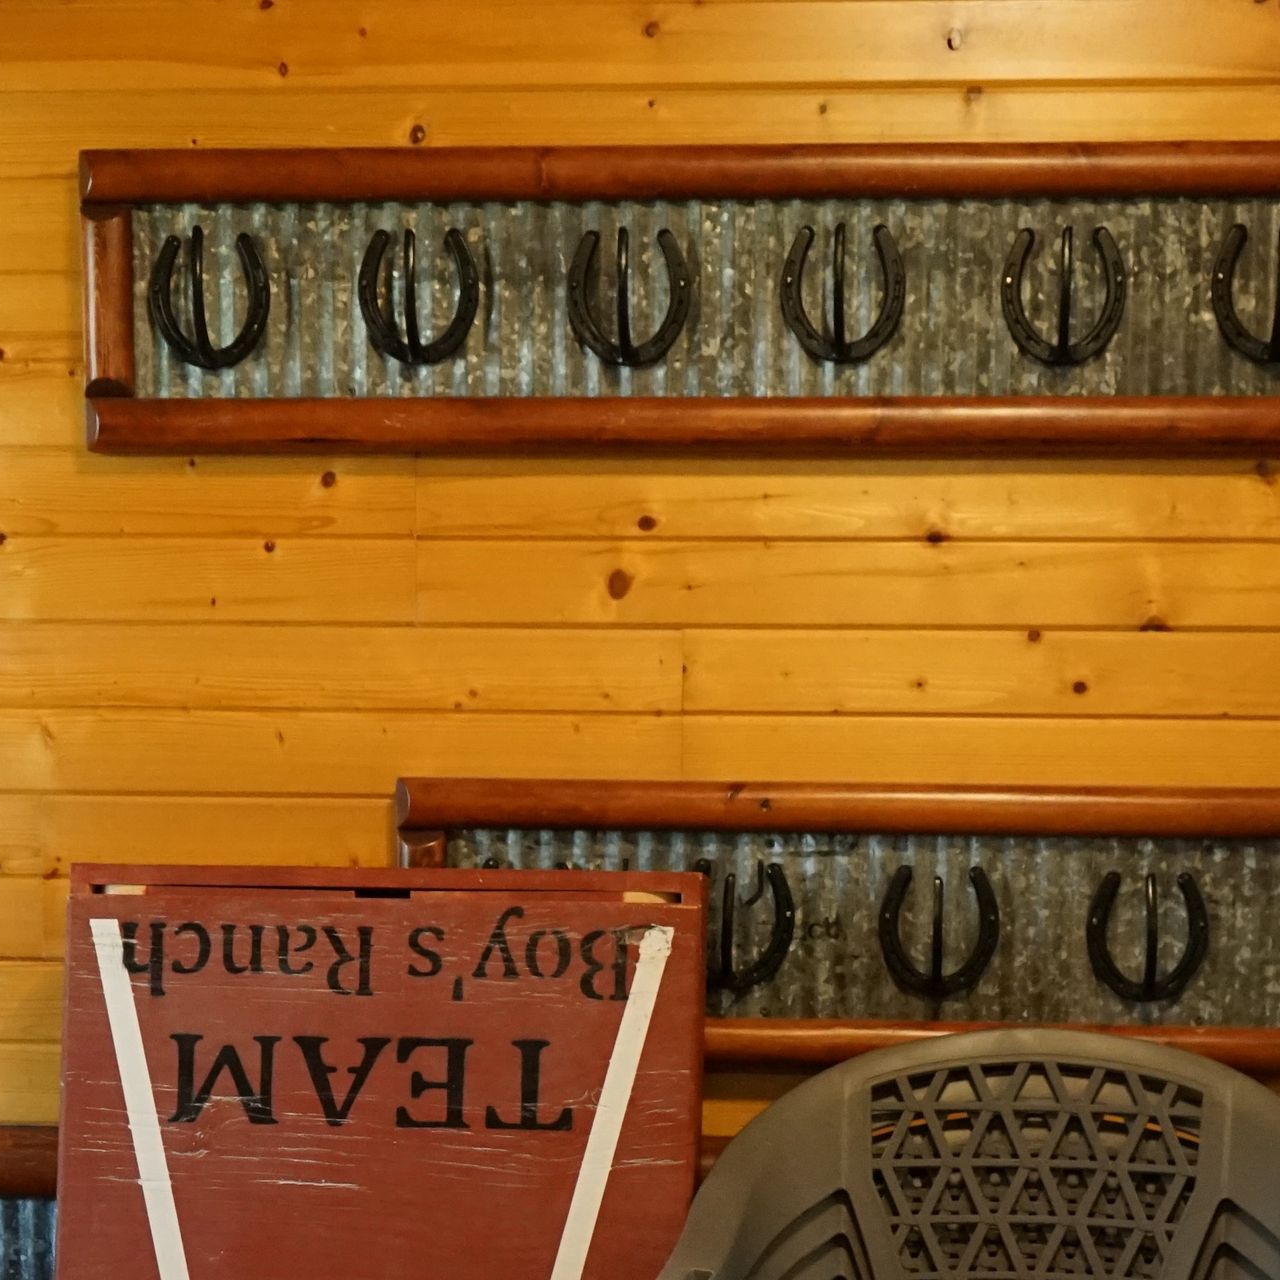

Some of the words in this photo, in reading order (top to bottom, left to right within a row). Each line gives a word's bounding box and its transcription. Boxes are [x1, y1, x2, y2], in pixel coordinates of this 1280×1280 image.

[121, 922, 374, 996] Ranch
[408, 906, 629, 1001] Boy's
[167, 1033, 574, 1131] TEAM
